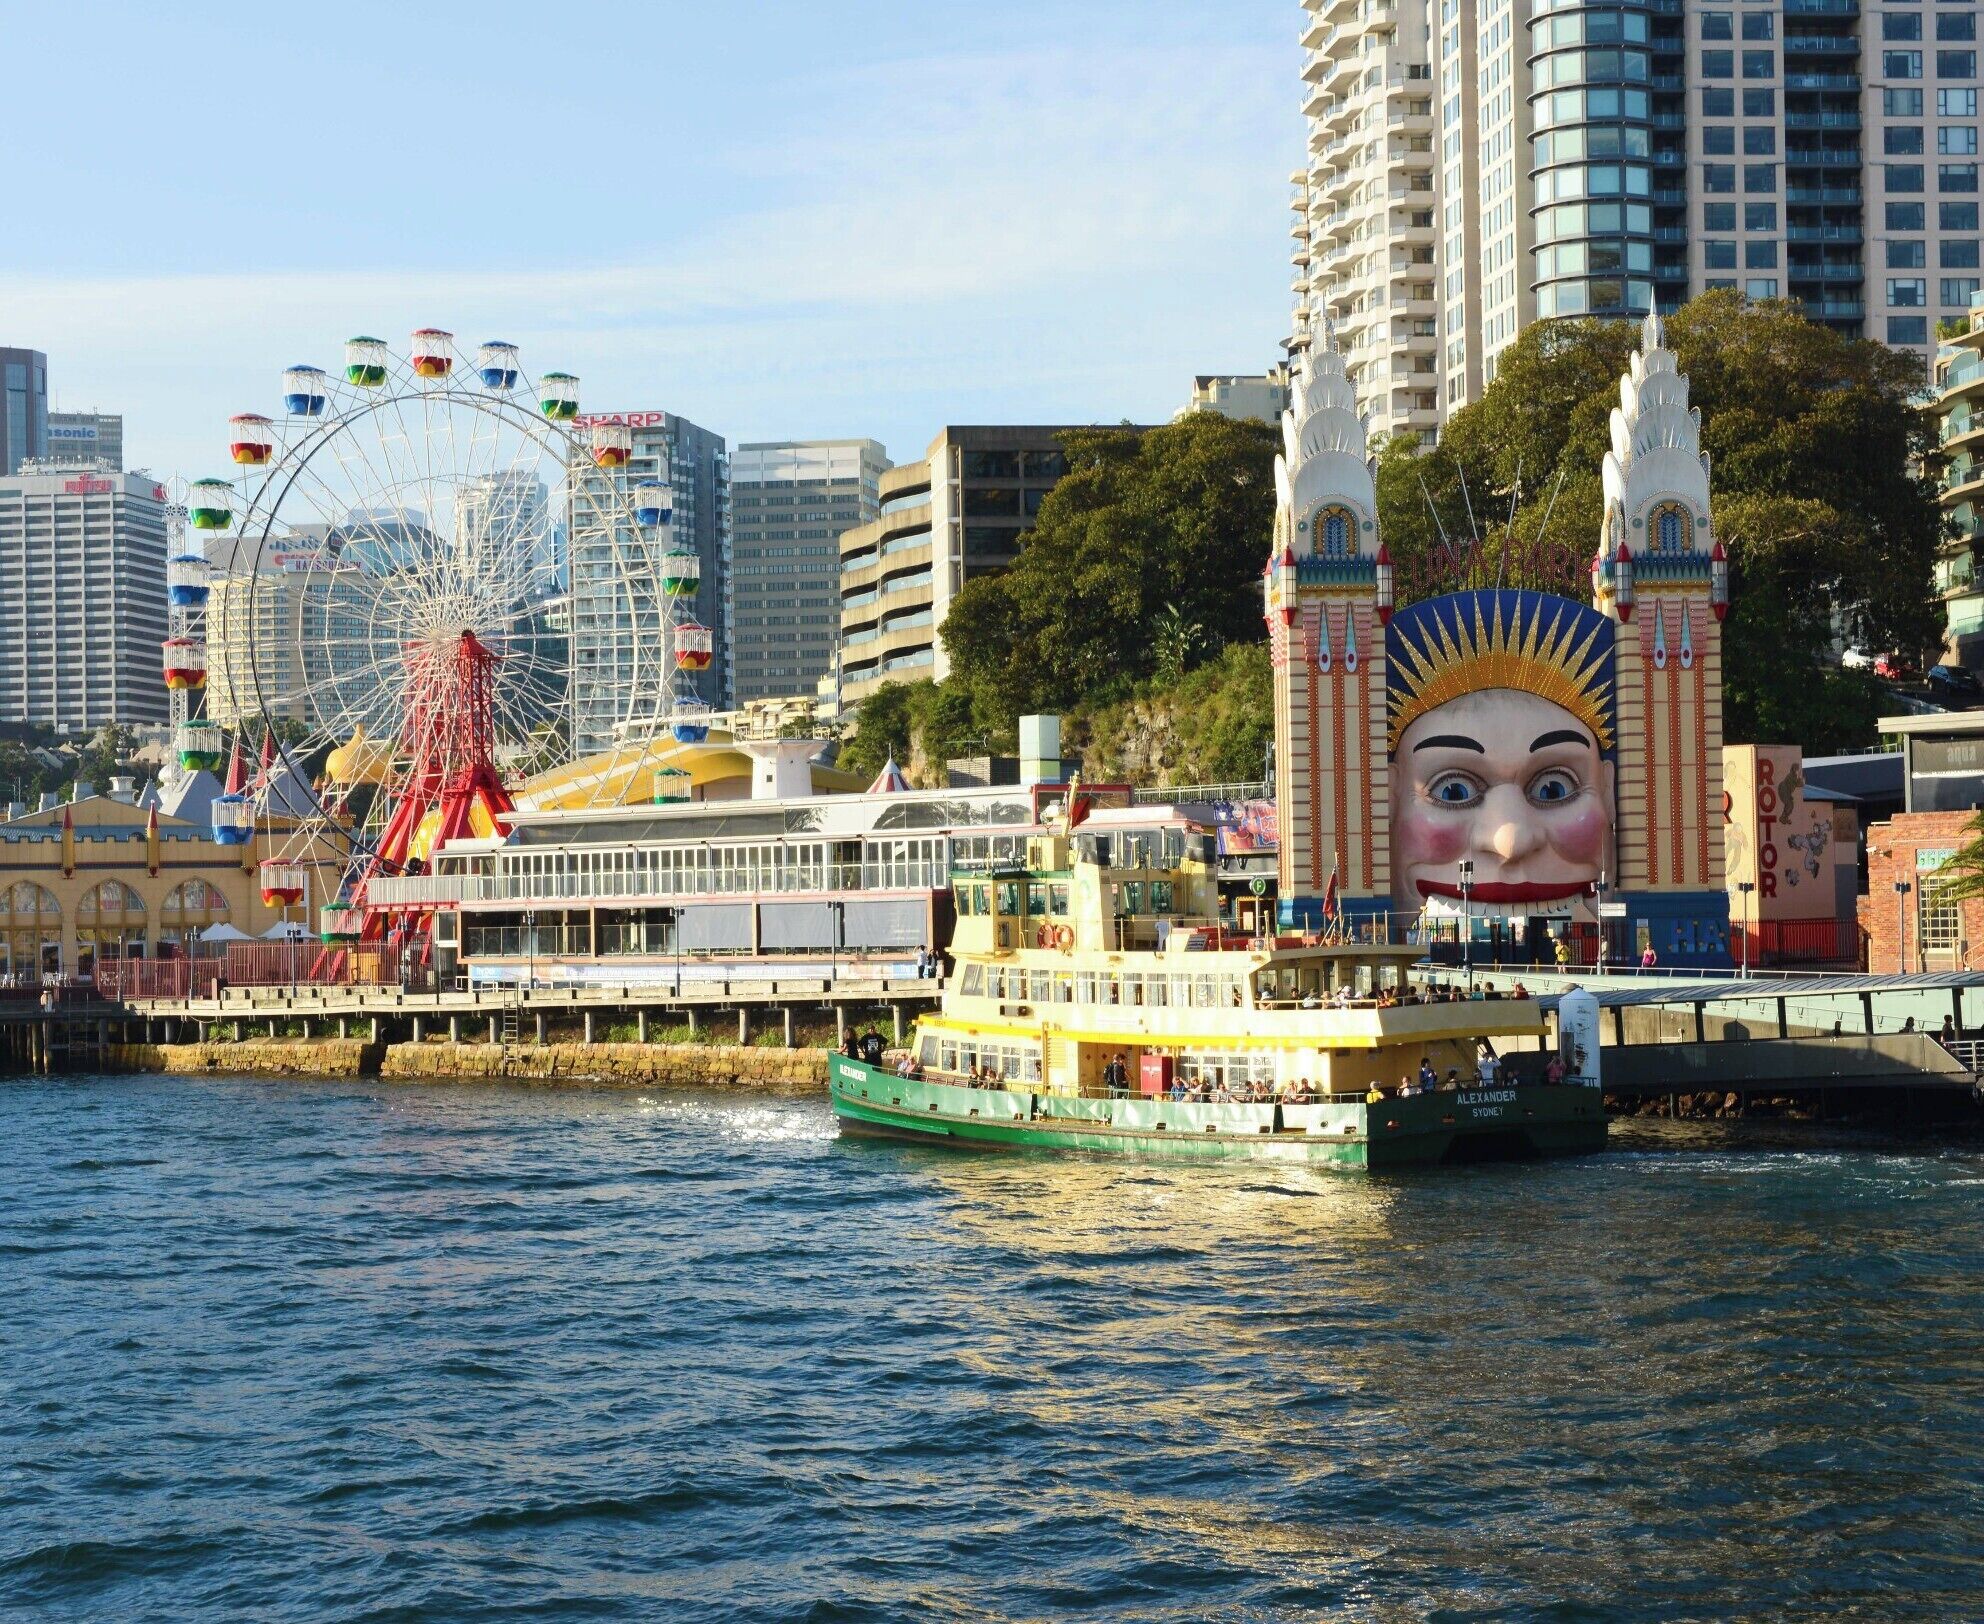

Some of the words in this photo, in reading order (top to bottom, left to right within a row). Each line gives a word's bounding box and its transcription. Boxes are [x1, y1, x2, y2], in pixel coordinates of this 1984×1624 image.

[572, 412, 662, 429] SHARP
[1391, 538, 1491, 597] LUNA
[1502, 538, 1598, 597] PARK
[1757, 758, 1778, 898] ROTOR
[1457, 1091, 1516, 1104] ALEXANDER
[1472, 1107, 1504, 1117] SYDNEY
